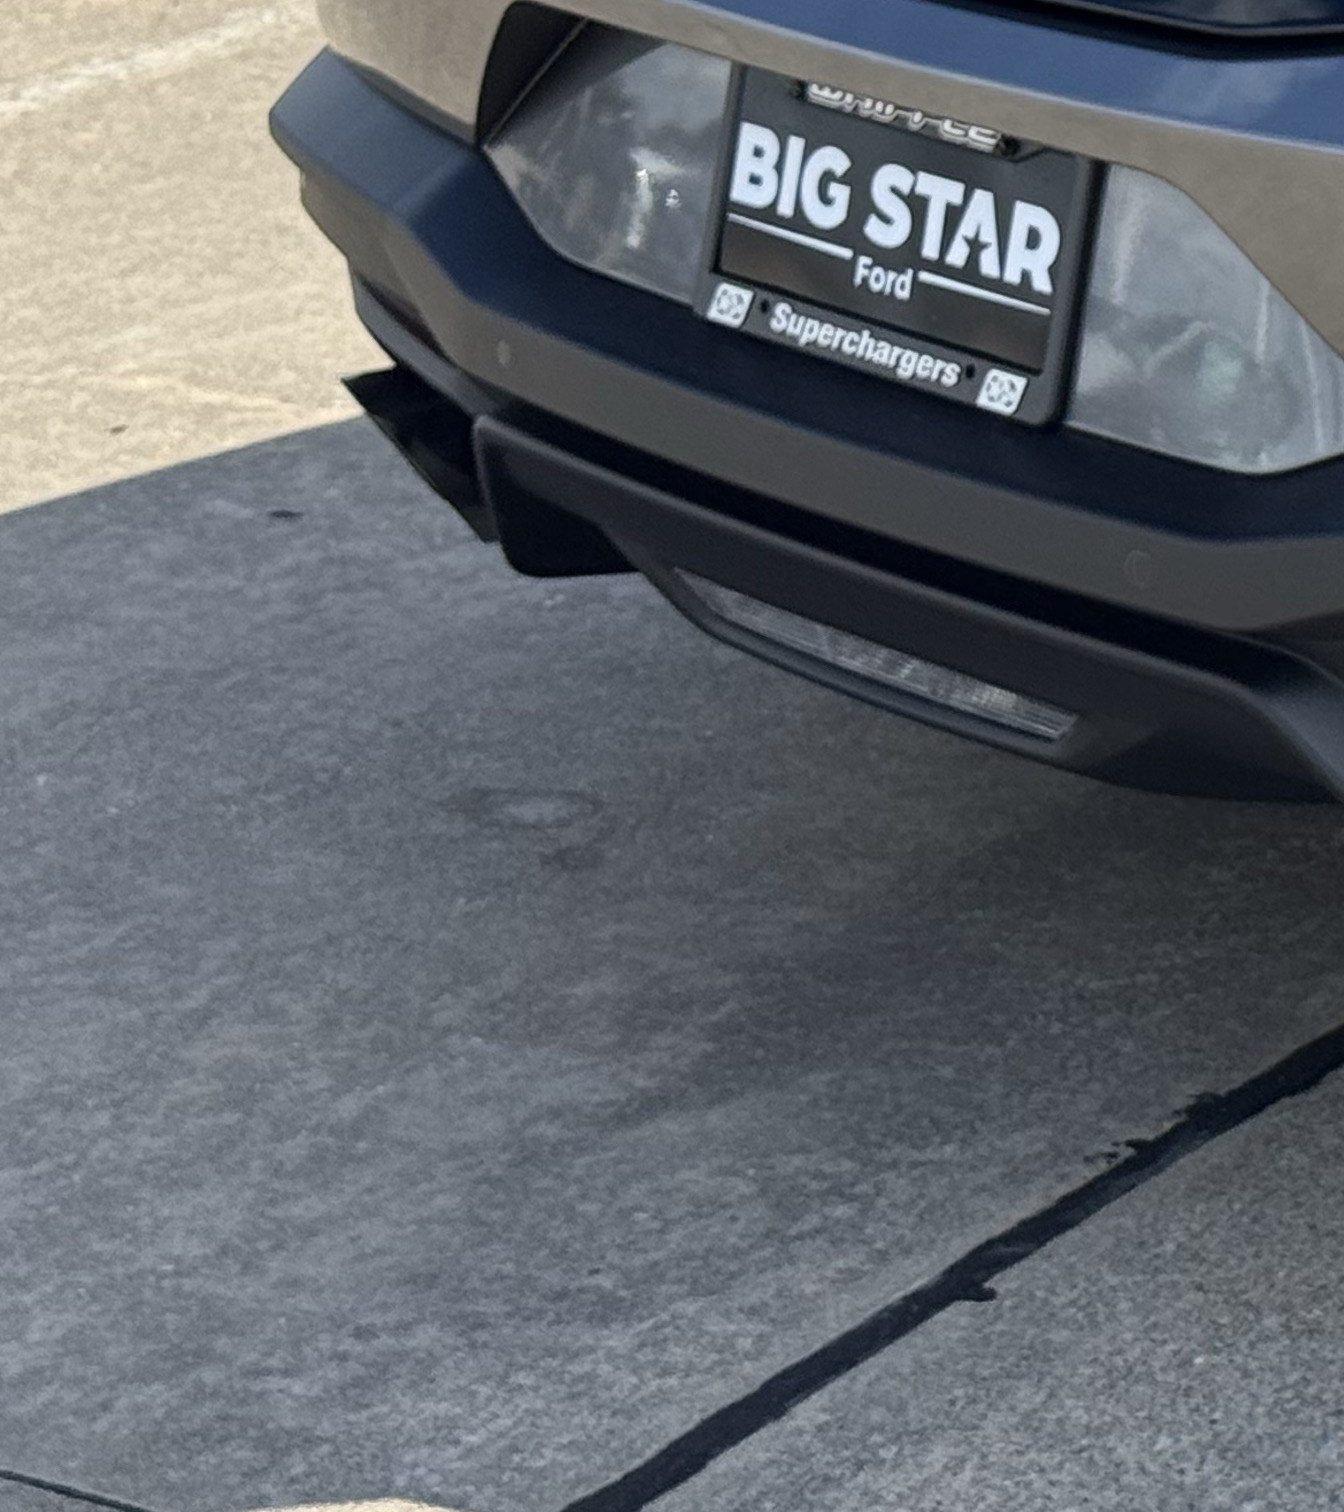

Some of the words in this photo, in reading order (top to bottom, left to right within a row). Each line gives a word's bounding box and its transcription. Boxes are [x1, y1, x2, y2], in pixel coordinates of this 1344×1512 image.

[728, 120, 852, 231] BIG
[862, 162, 1061, 294] STAR
[853, 254, 915, 301] Ford
[769, 304, 961, 387] Superchargers
